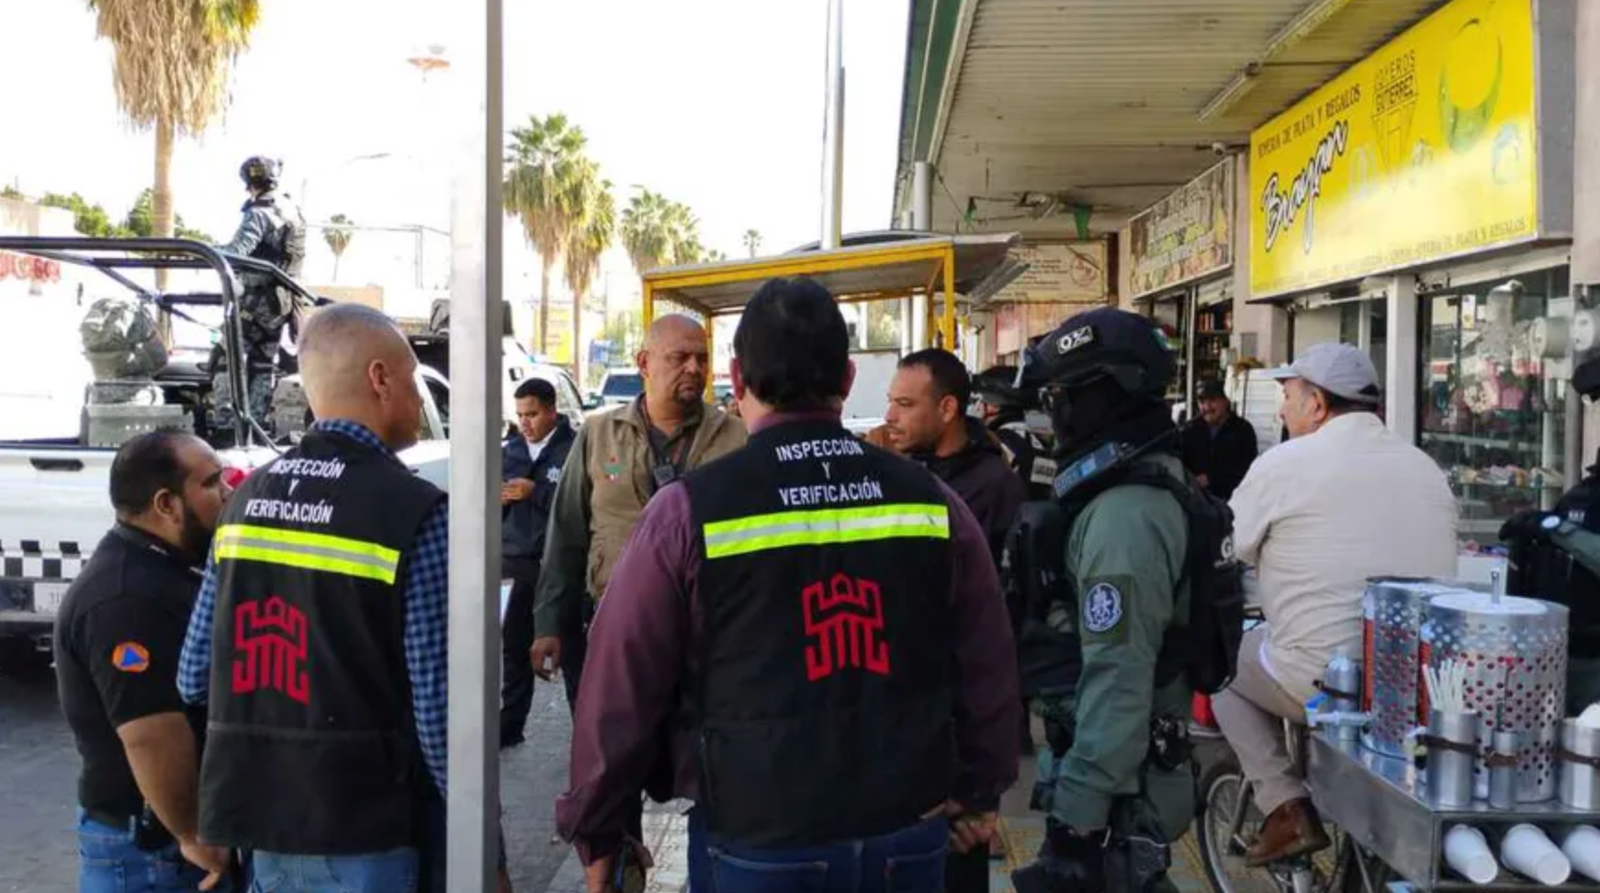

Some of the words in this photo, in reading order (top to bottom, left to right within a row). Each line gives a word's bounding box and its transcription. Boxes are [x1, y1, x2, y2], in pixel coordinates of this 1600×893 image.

[1260, 119, 1348, 254] Brayan
[776, 437, 863, 461] INSPECCIÓN
[268, 457, 346, 479] INSPECCIÓN
[822, 461, 831, 480] Y
[288, 478, 300, 496] Y
[779, 477, 882, 505] VERIFICACIÓN
[245, 499, 334, 524] VERIFICACIÓN
